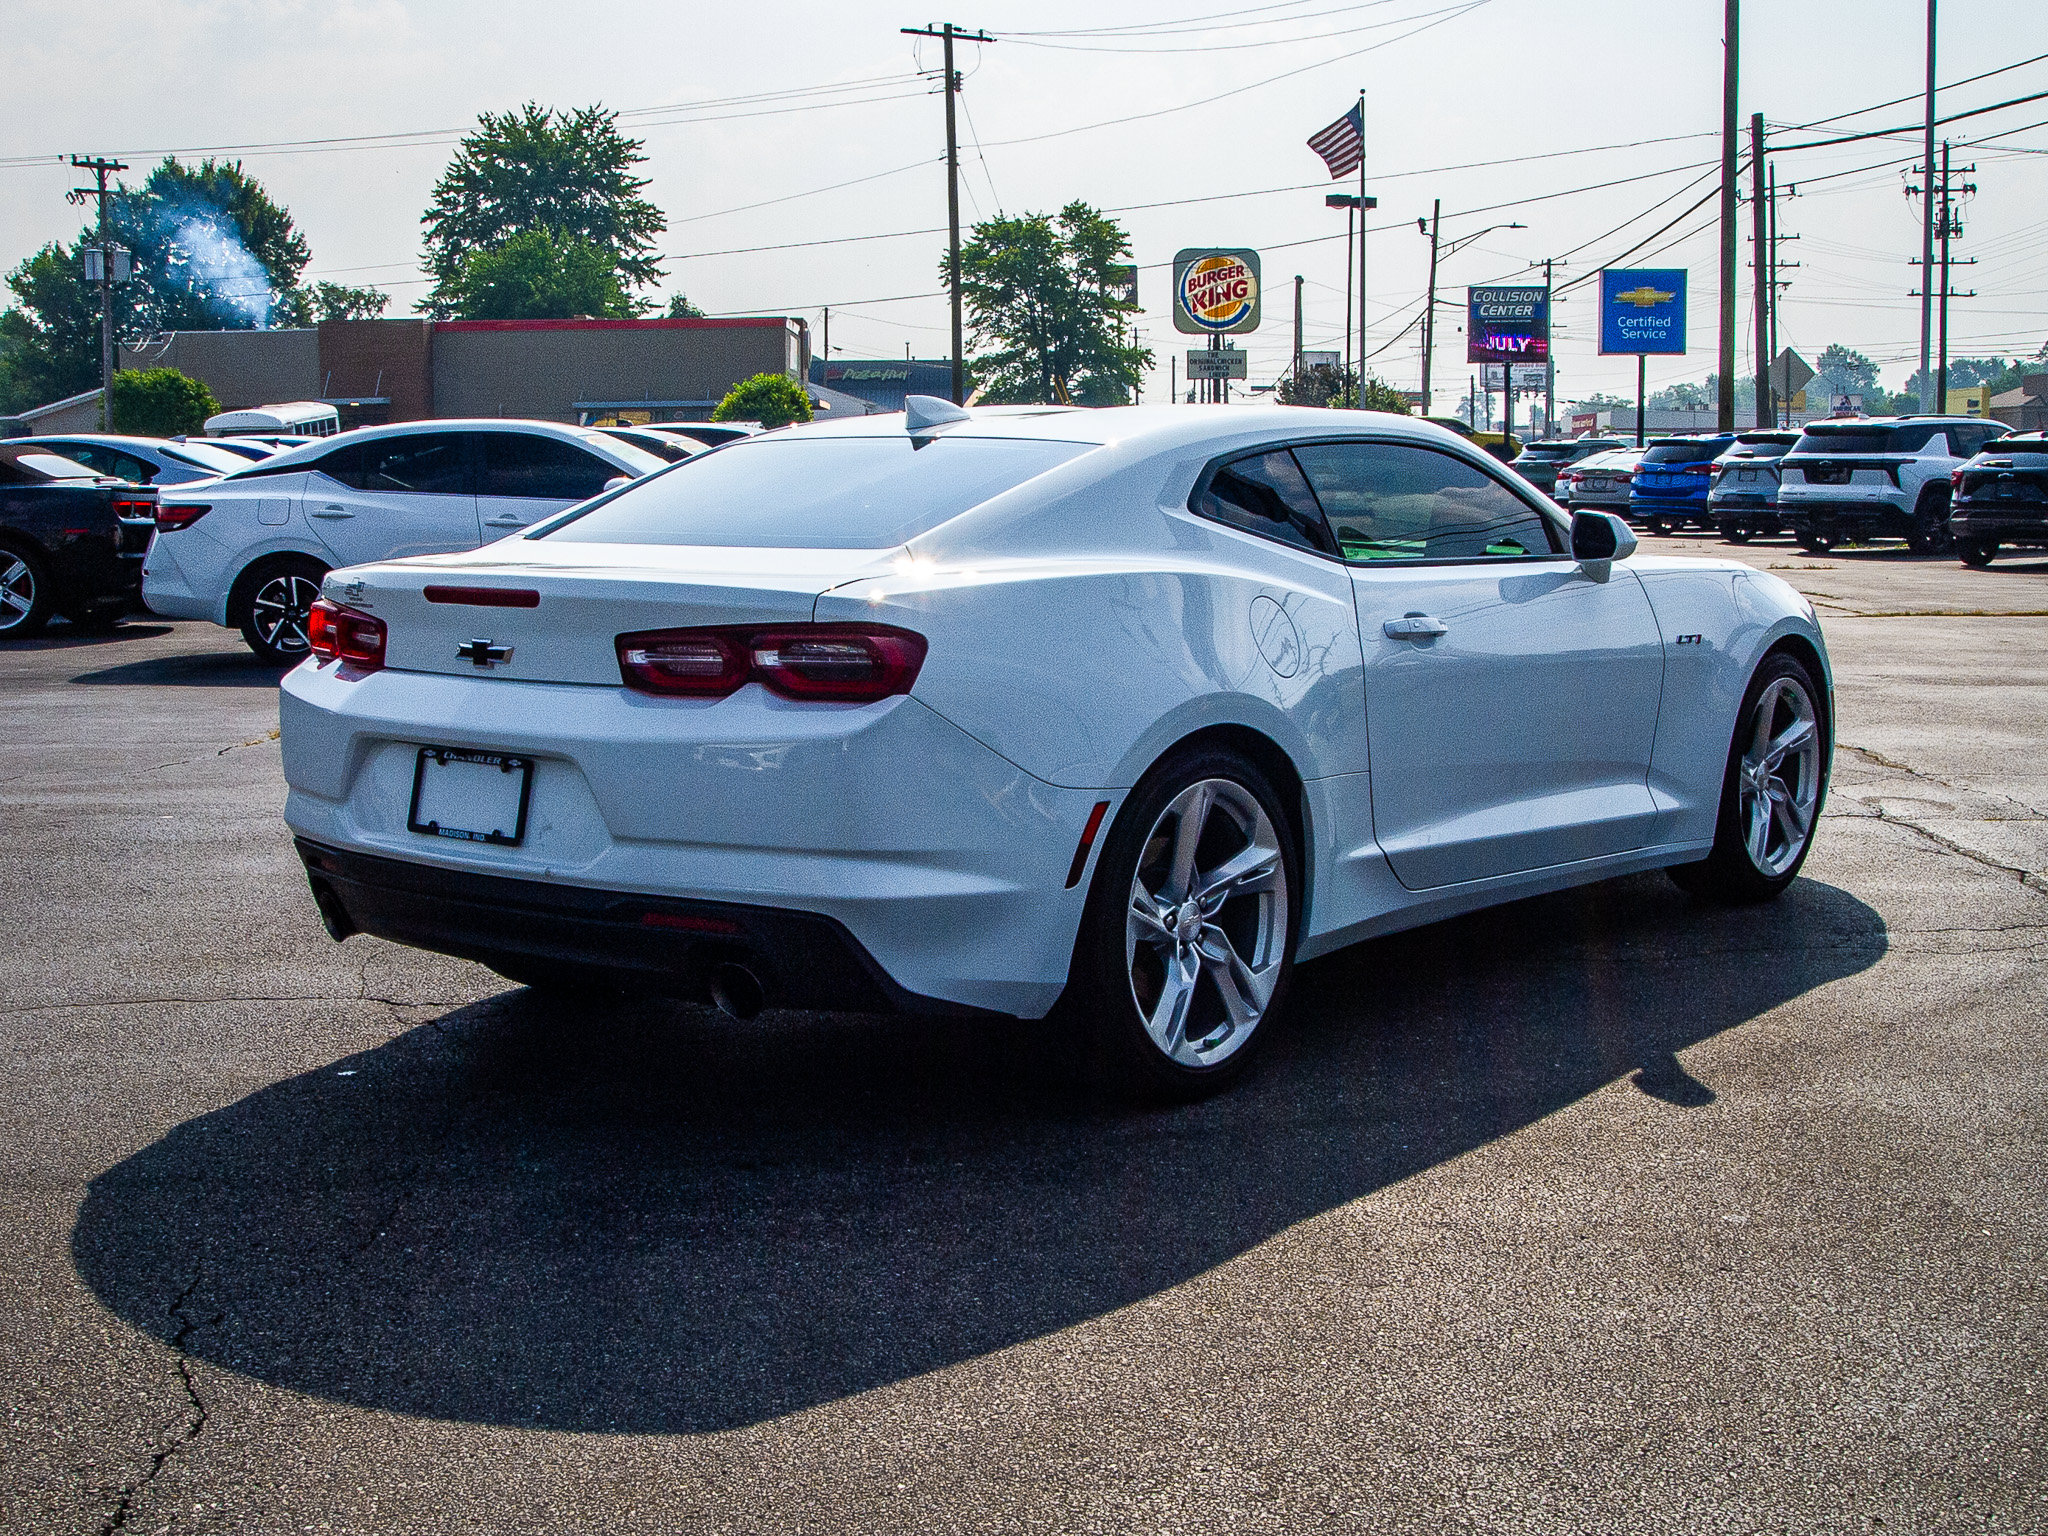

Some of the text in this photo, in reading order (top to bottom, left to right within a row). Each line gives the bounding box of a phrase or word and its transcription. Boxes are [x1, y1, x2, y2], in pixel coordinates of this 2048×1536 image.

[1188, 265, 1245, 293] BURGER
[1192, 279, 1249, 314] KING
[1473, 290, 1543, 302] COLLISION
[1480, 304, 1533, 316] CENTER
[1618, 316, 1671, 327] Certified
[1622, 329, 1667, 339] Service
[1486, 336, 1531, 352] JULY
